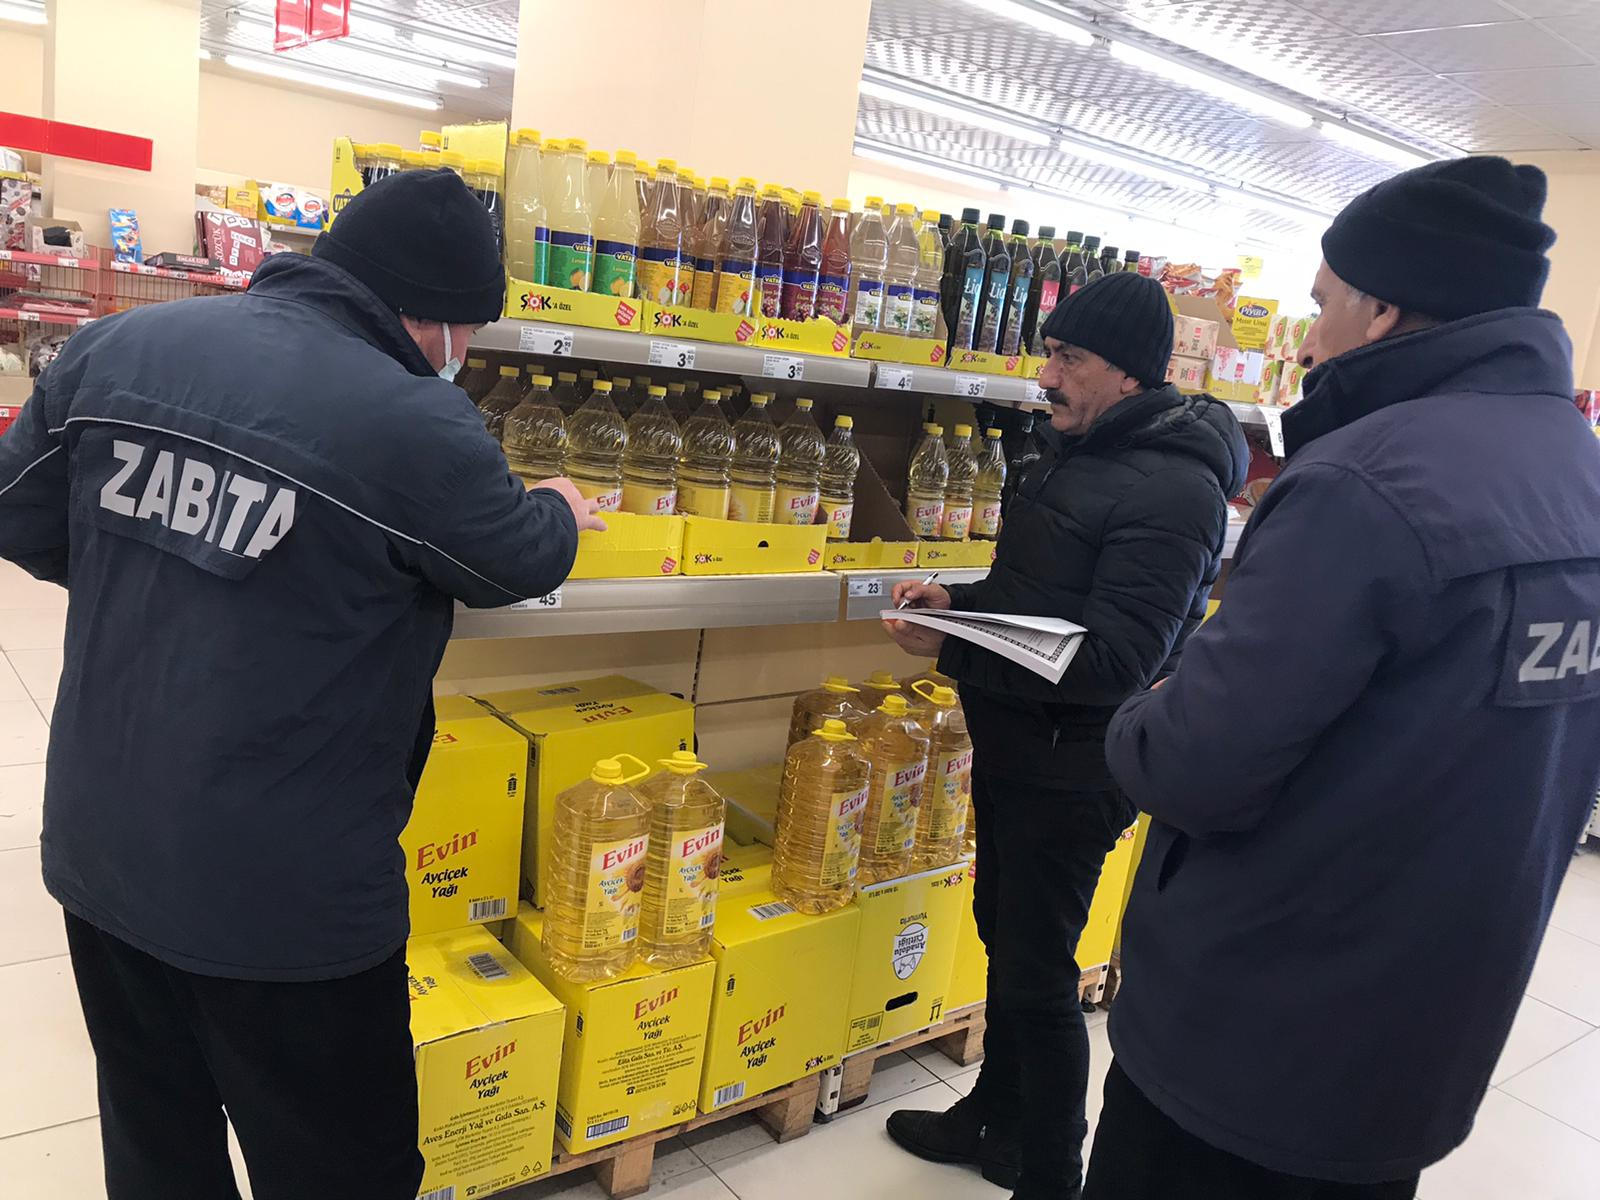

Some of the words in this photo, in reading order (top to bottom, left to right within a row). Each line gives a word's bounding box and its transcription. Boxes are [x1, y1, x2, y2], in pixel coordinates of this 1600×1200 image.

[100, 440, 296, 558] ZABITA
[915, 504, 942, 518] Evin
[867, 582, 879, 594] 23
[894, 764, 925, 787] Evin
[838, 790, 868, 817] Evin
[416, 831, 479, 871] Evin
[681, 828, 720, 858] Evin
[602, 839, 644, 871] Evin
[421, 865, 468, 885] Ayçiçek
[431, 883, 458, 898] Yağı
[894, 941, 926, 956] Anadolu
[633, 988, 679, 1021] Evin
[637, 1014, 671, 1031] Ayçiçek
[737, 1003, 786, 1046] Evin
[643, 1029, 663, 1041] Yağı
[740, 1037, 776, 1058] Ayçiçek
[466, 1040, 517, 1080] Evin
[746, 1053, 768, 1069] Yağı
[469, 1070, 509, 1090] Ayçiçek
[477, 1085, 500, 1100] Yağı
[422, 1133, 442, 1146] Aves
[444, 1124, 468, 1139] Enerji
[468, 1118, 484, 1131] Yağ
[485, 1117, 494, 1125] ve
[495, 1110, 512, 1123] Gıda
